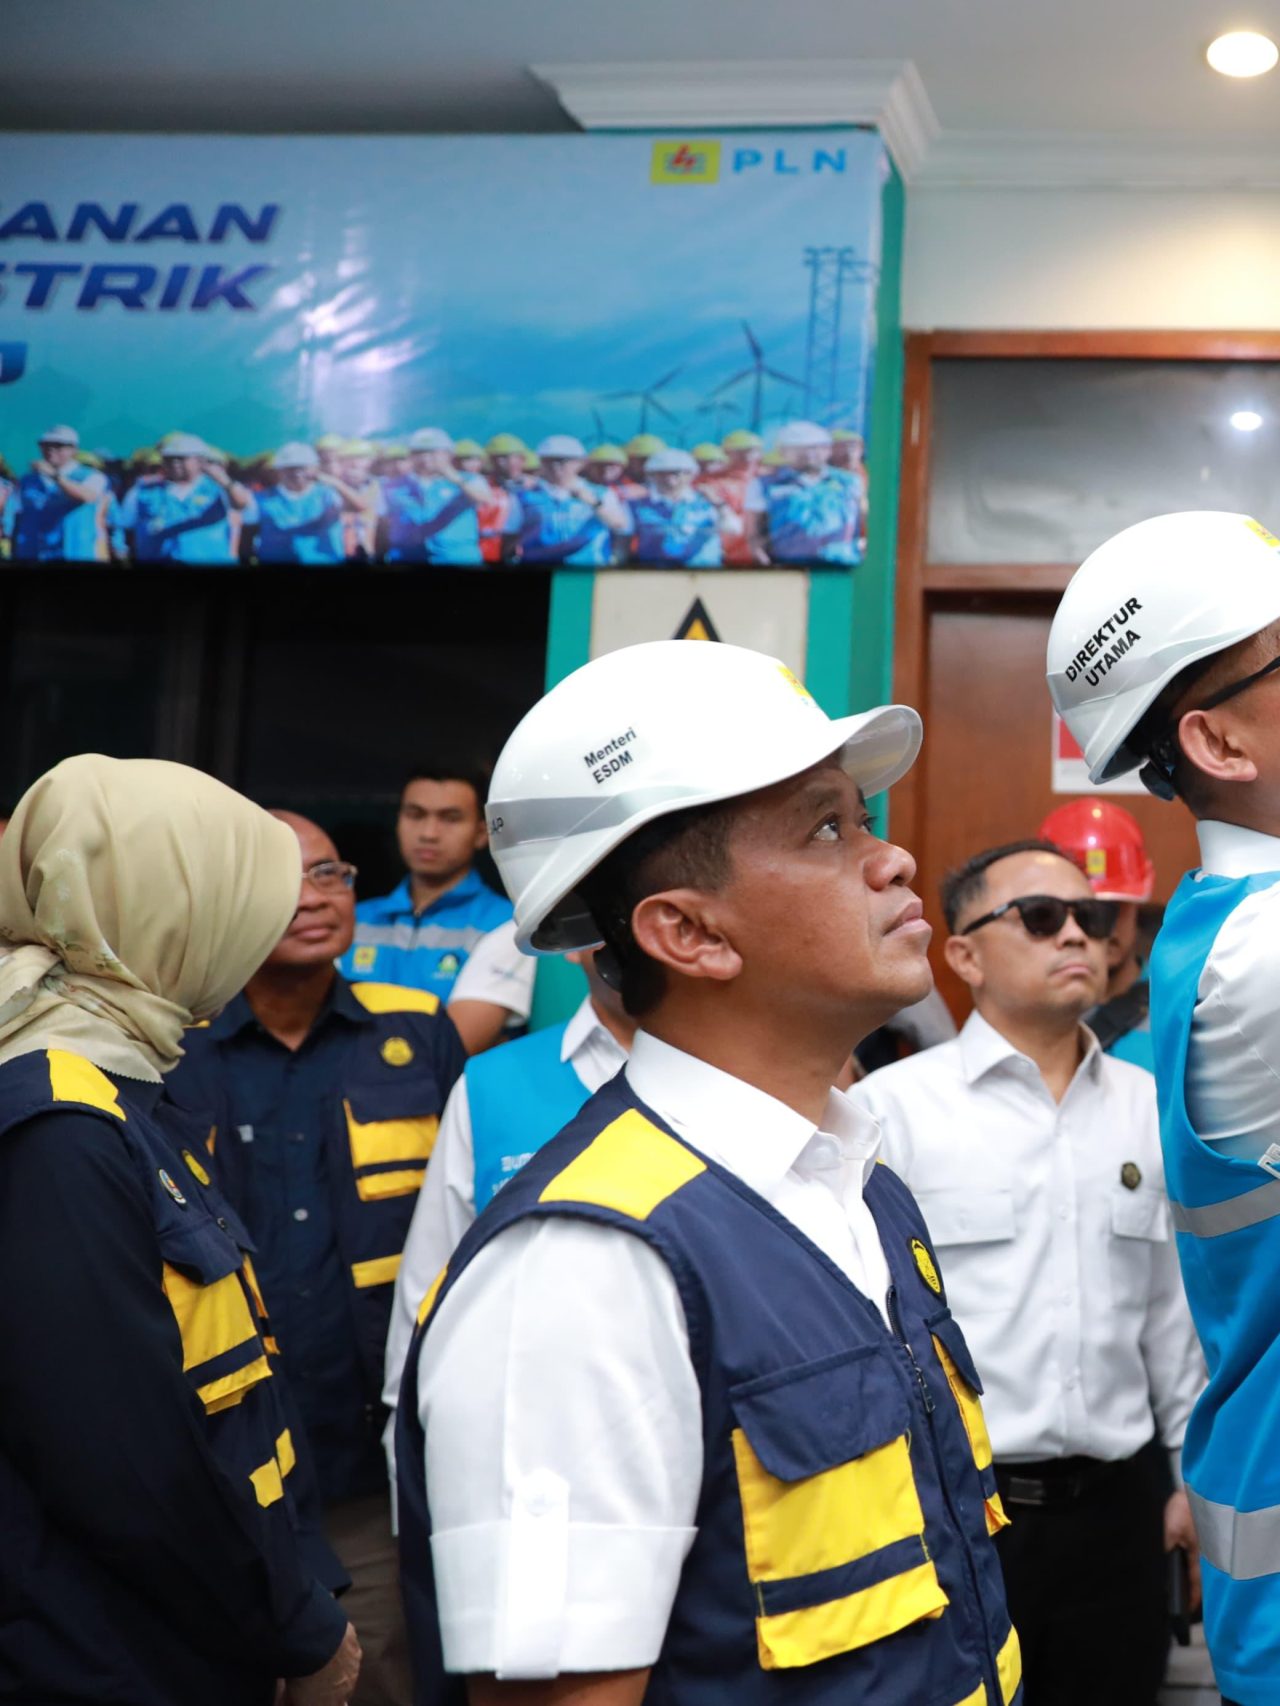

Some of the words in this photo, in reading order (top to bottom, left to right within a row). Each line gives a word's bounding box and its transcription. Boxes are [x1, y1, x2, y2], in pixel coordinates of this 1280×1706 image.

[733, 148, 846, 174] PLN
[0, 202, 279, 242] ANAN
[1065, 597, 1143, 682] DIREKTUR
[1085, 629, 1141, 687] UTAMA
[584, 726, 637, 768] Menteri
[592, 750, 634, 784] ESDM
